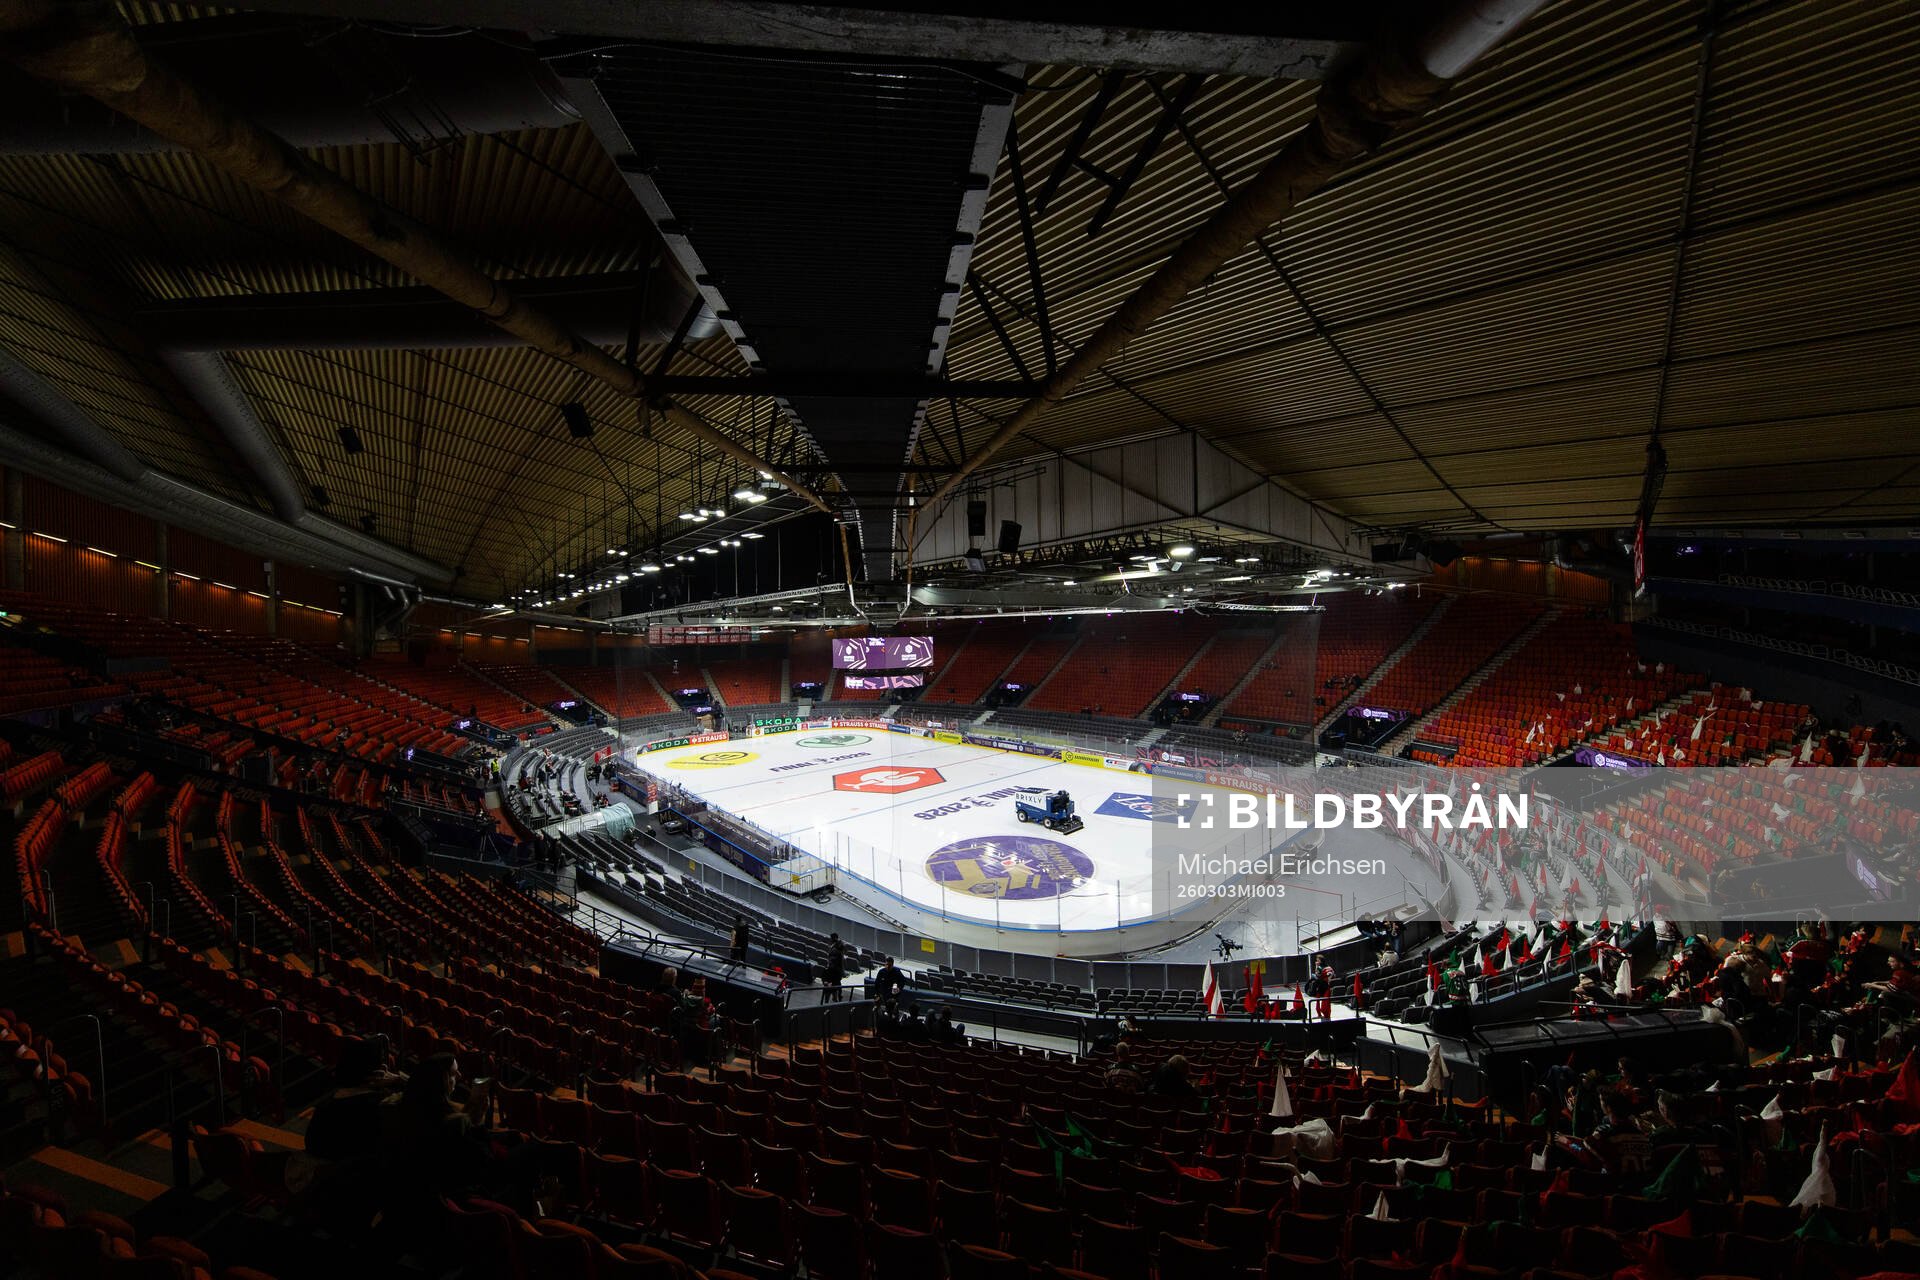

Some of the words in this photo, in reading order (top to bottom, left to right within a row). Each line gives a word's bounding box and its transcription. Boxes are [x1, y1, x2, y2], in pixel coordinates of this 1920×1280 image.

[839, 720, 864, 728] STRAUSS
[697, 733, 727, 743] STRAUSS
[1219, 776, 1264, 793] STRAUSS
[1015, 793, 1042, 803] BRIXLY
[913, 802, 970, 820] 2026
